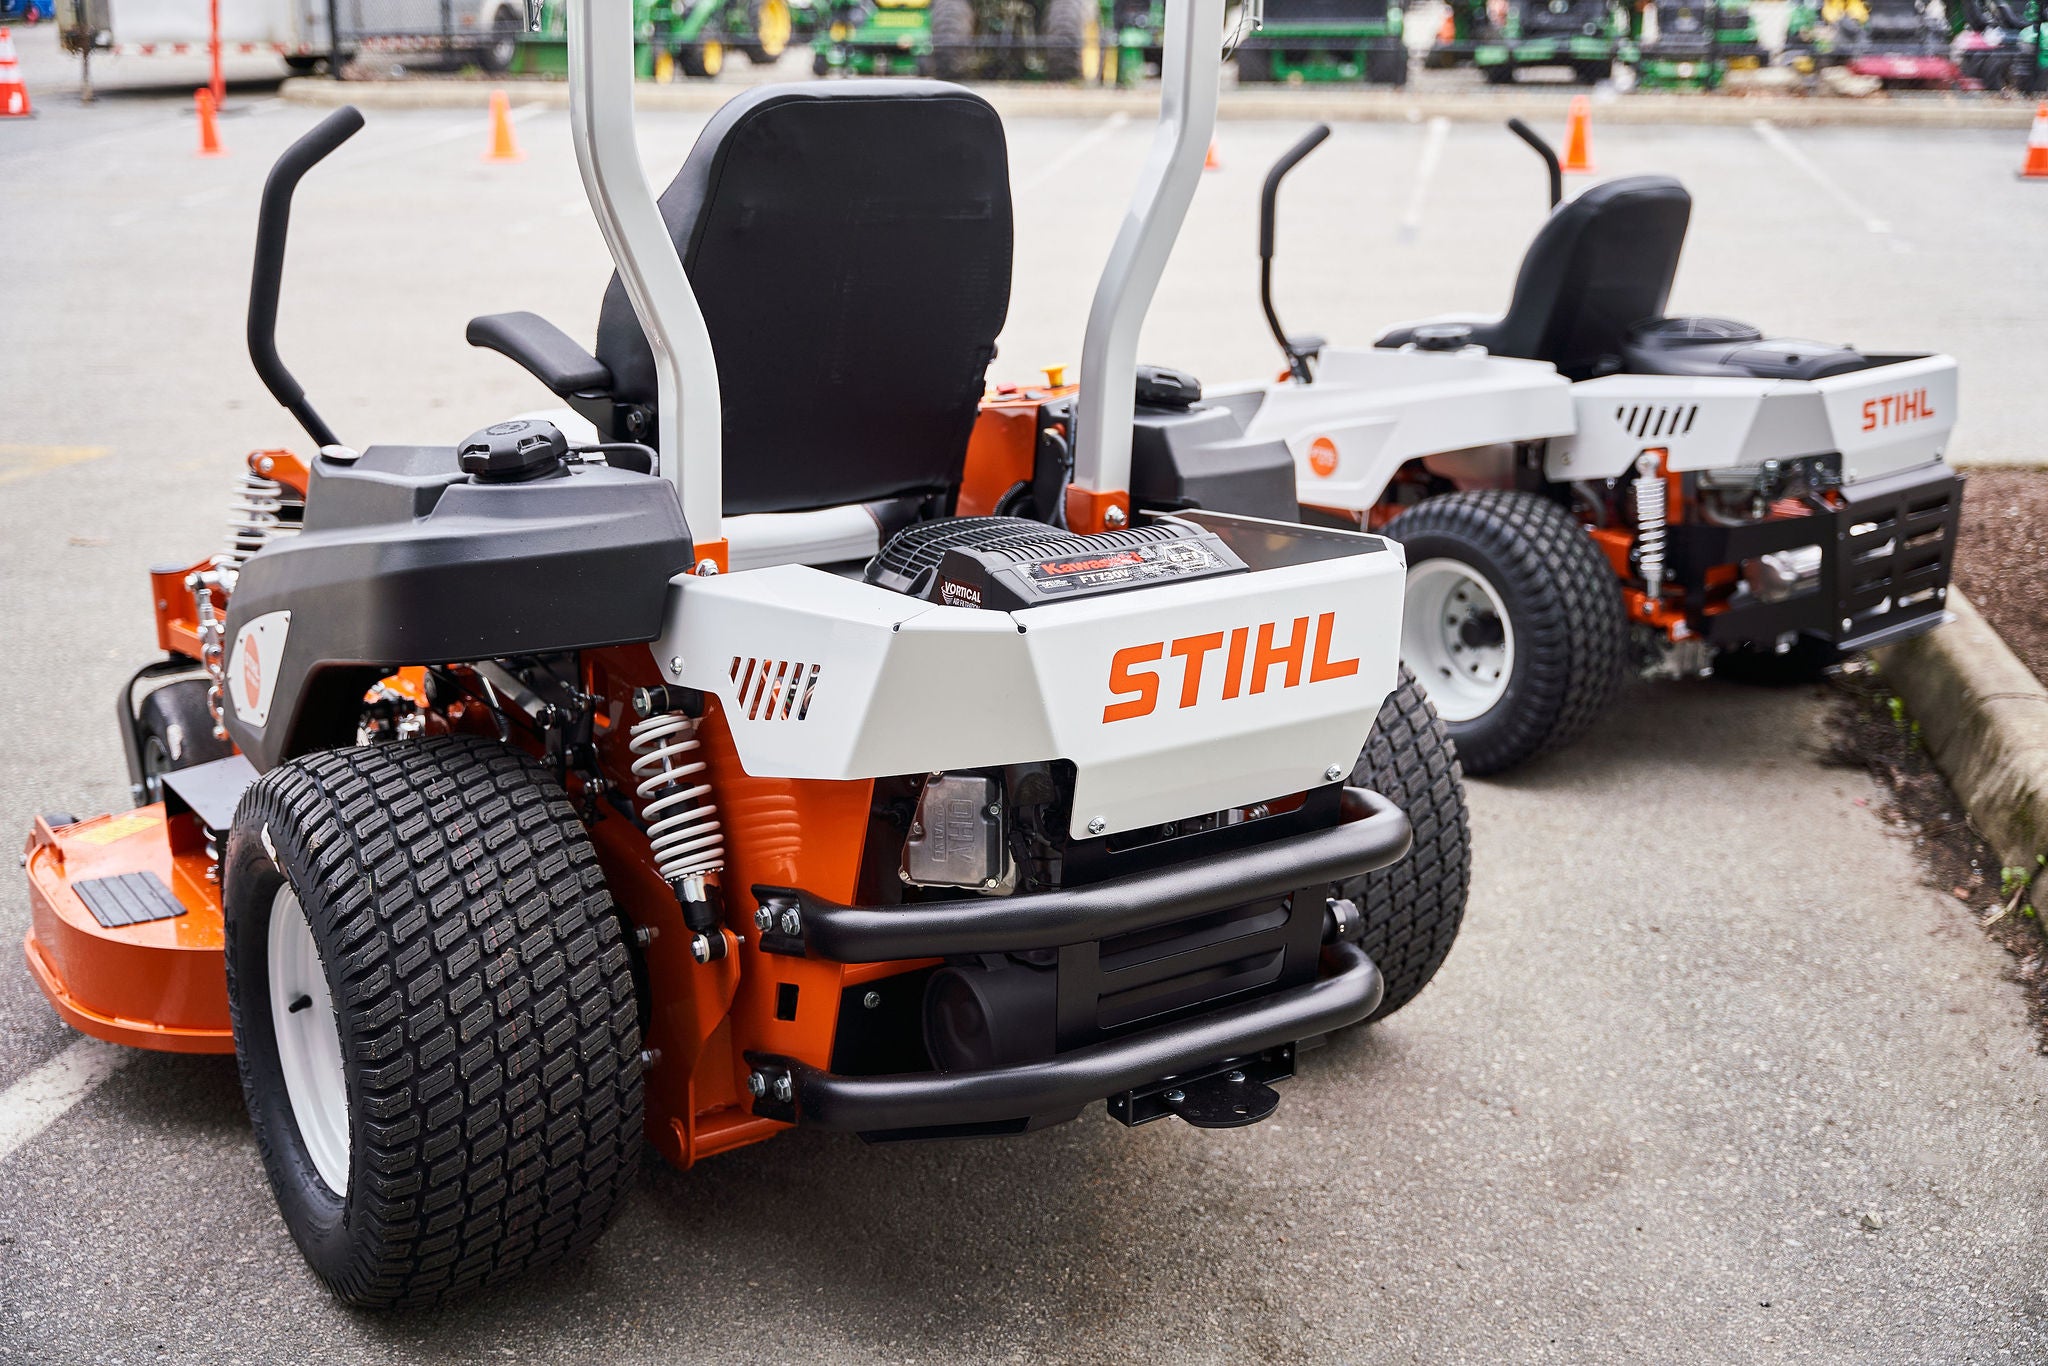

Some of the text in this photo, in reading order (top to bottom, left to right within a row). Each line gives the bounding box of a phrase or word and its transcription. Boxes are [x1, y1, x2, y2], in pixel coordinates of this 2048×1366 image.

[1862, 388, 1935, 431] STIHL
[944, 581, 982, 604] VORTICAL
[1102, 612, 1360, 724] STIHL
[948, 799, 975, 863] OHV
